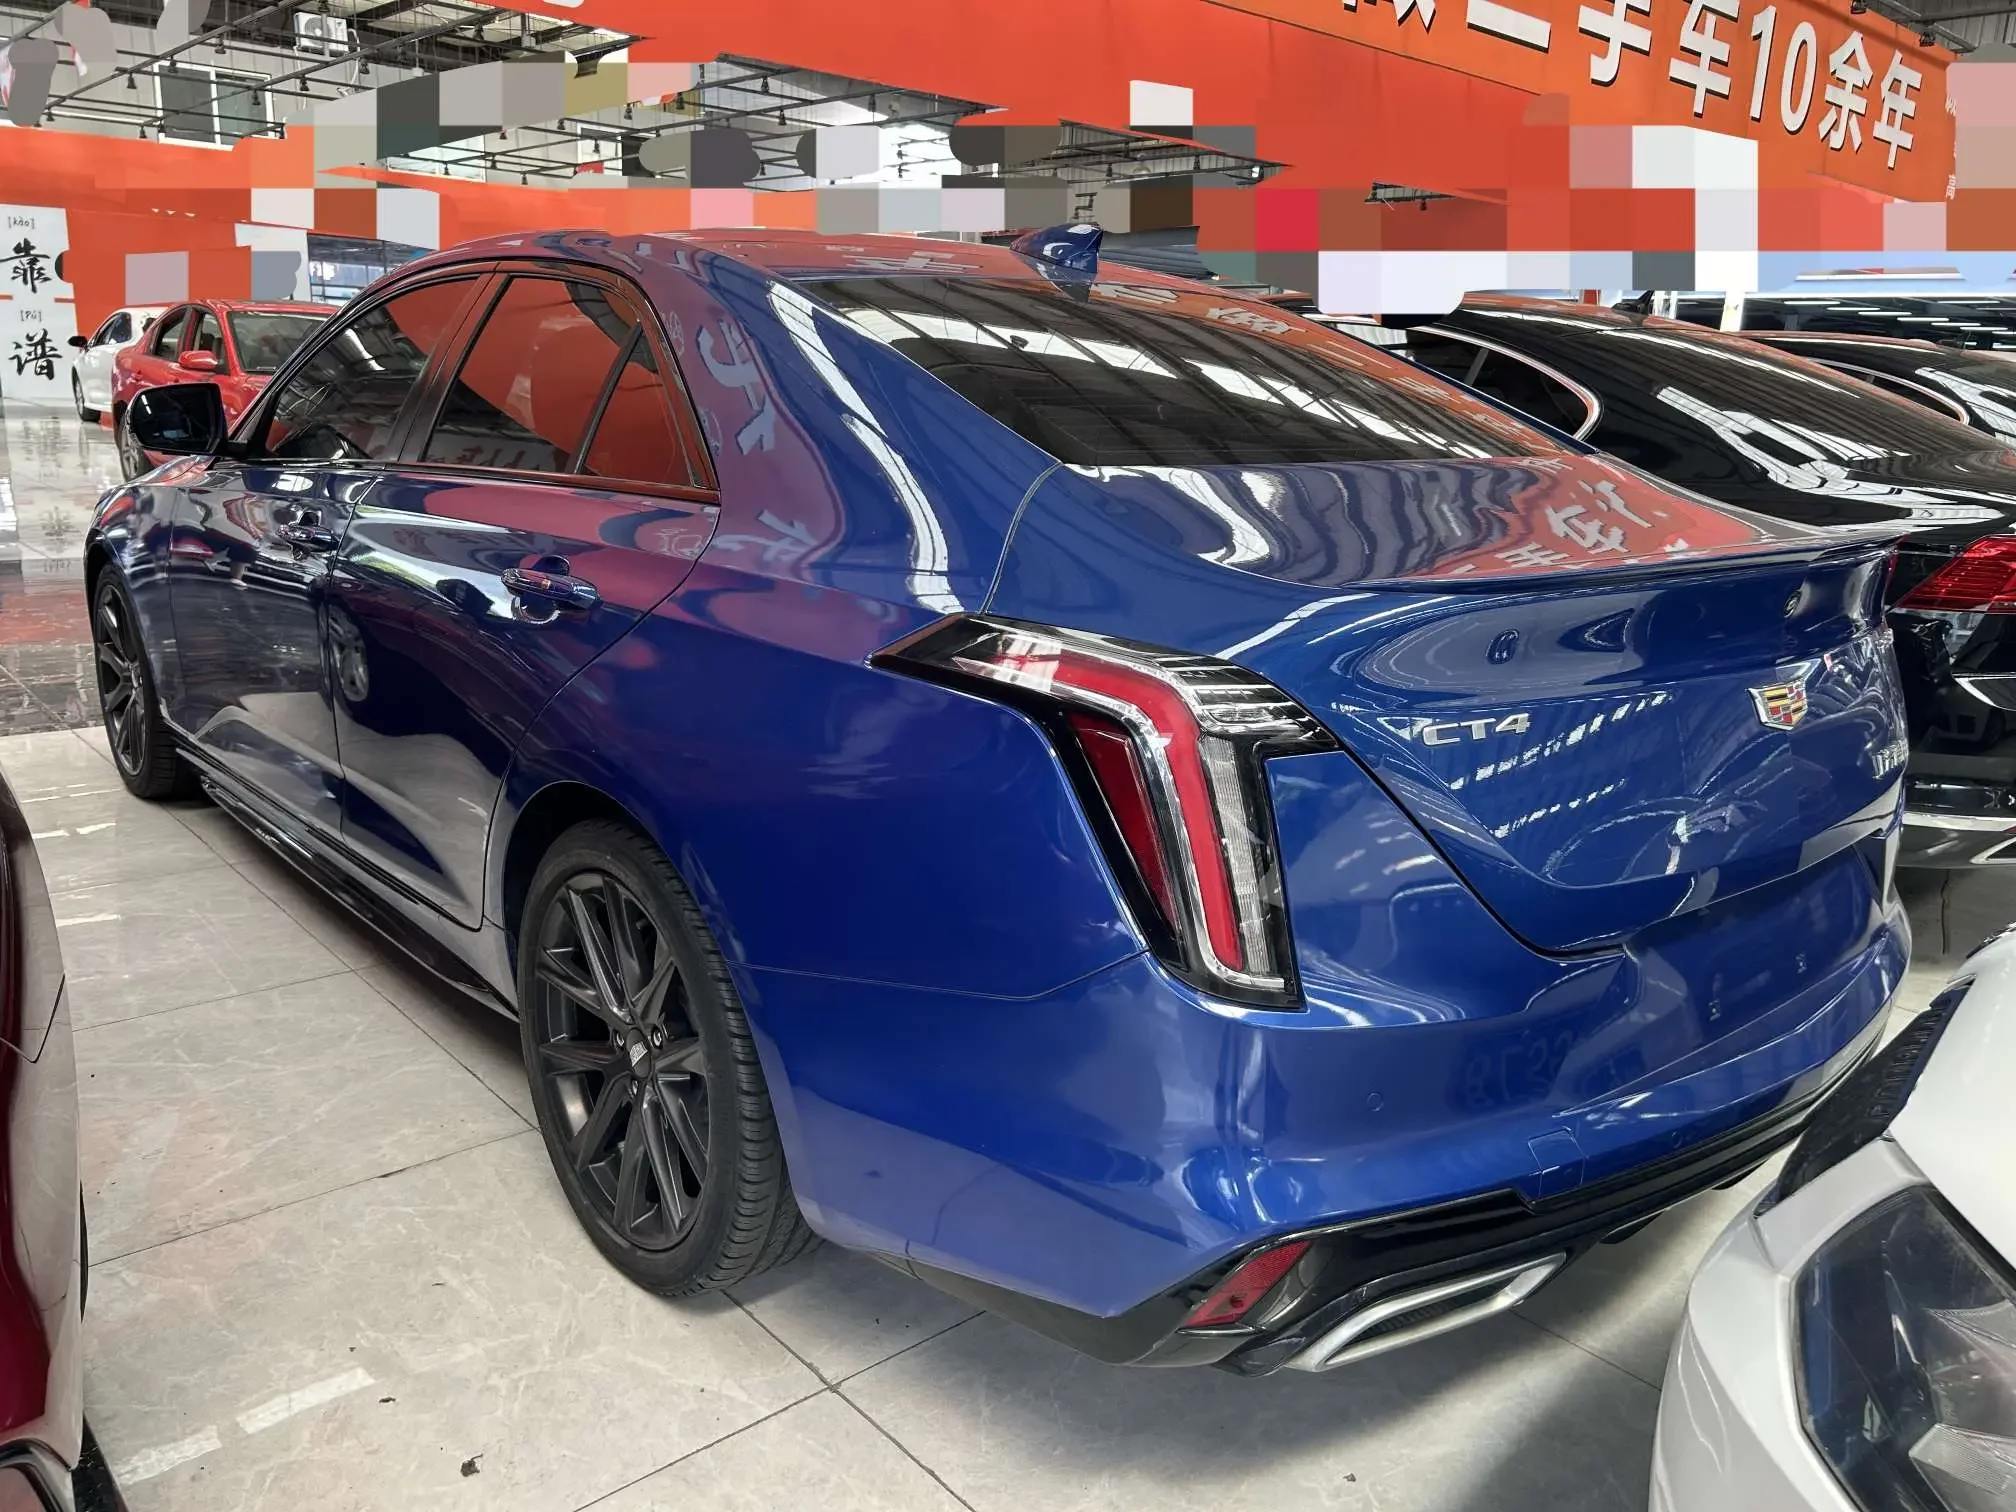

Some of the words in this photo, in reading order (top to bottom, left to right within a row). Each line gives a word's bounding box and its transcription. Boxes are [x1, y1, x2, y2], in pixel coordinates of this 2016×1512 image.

[0, 237, 52, 294] 靠
[8, 327, 63, 381] 谱
[1422, 712, 1531, 746] CT4
